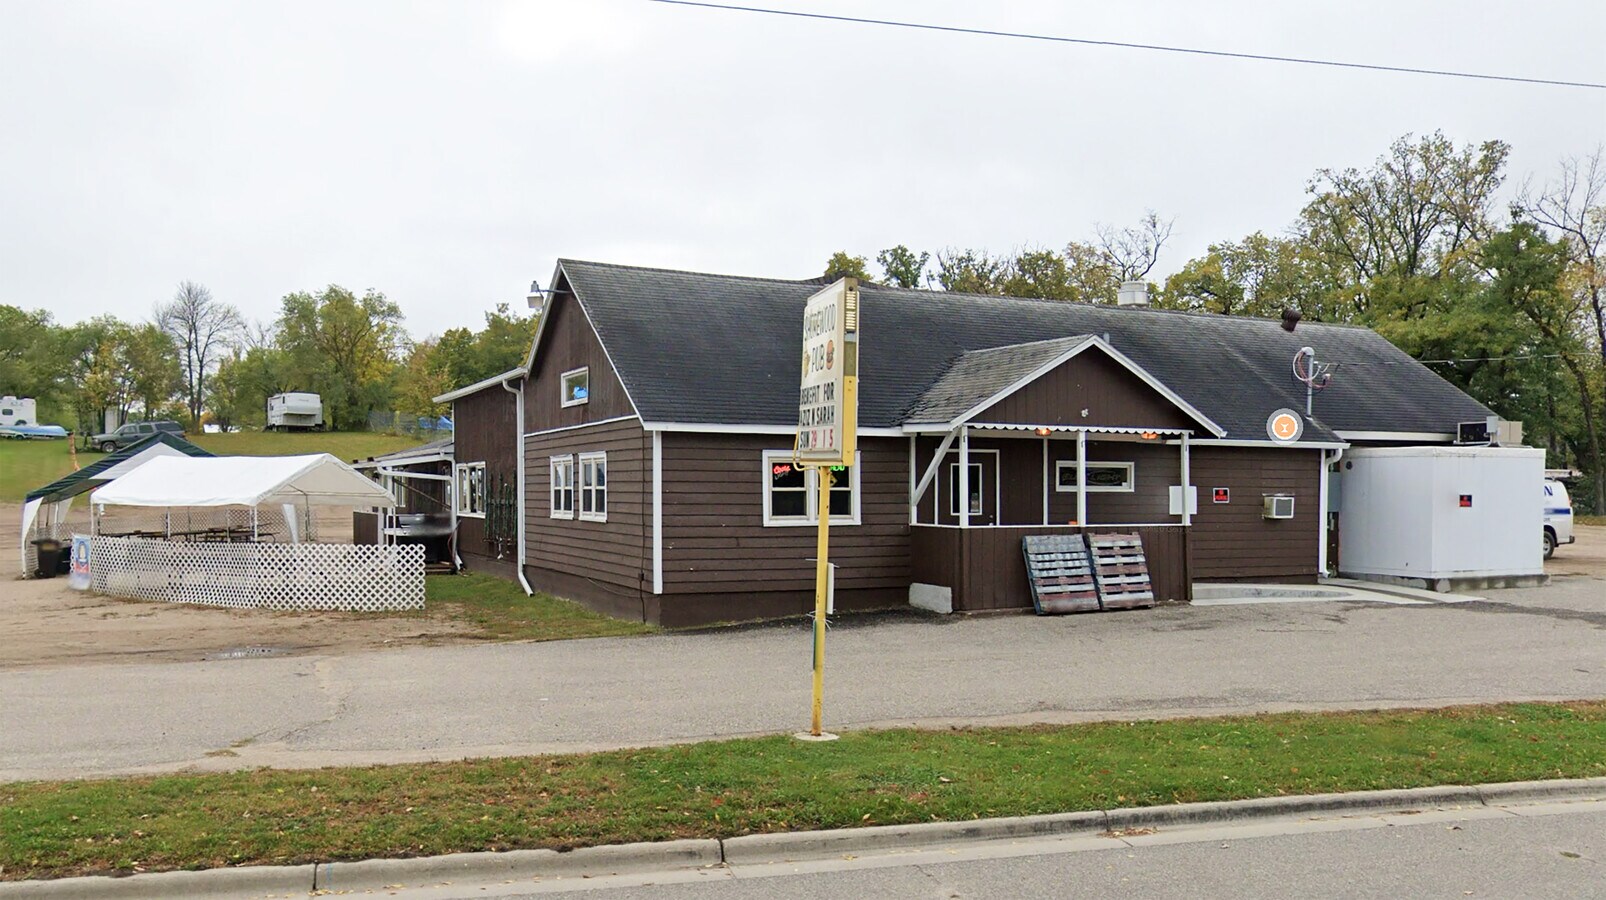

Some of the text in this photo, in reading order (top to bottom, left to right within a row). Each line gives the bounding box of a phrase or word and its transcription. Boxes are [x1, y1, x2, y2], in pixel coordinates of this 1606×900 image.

[805, 304, 836, 341] SHOREWOOD
[812, 344, 825, 373] PUB
[801, 382, 834, 405] BENEFIT FOR
[816, 404, 835, 425] SARAH
[800, 430, 810, 448] SUN
